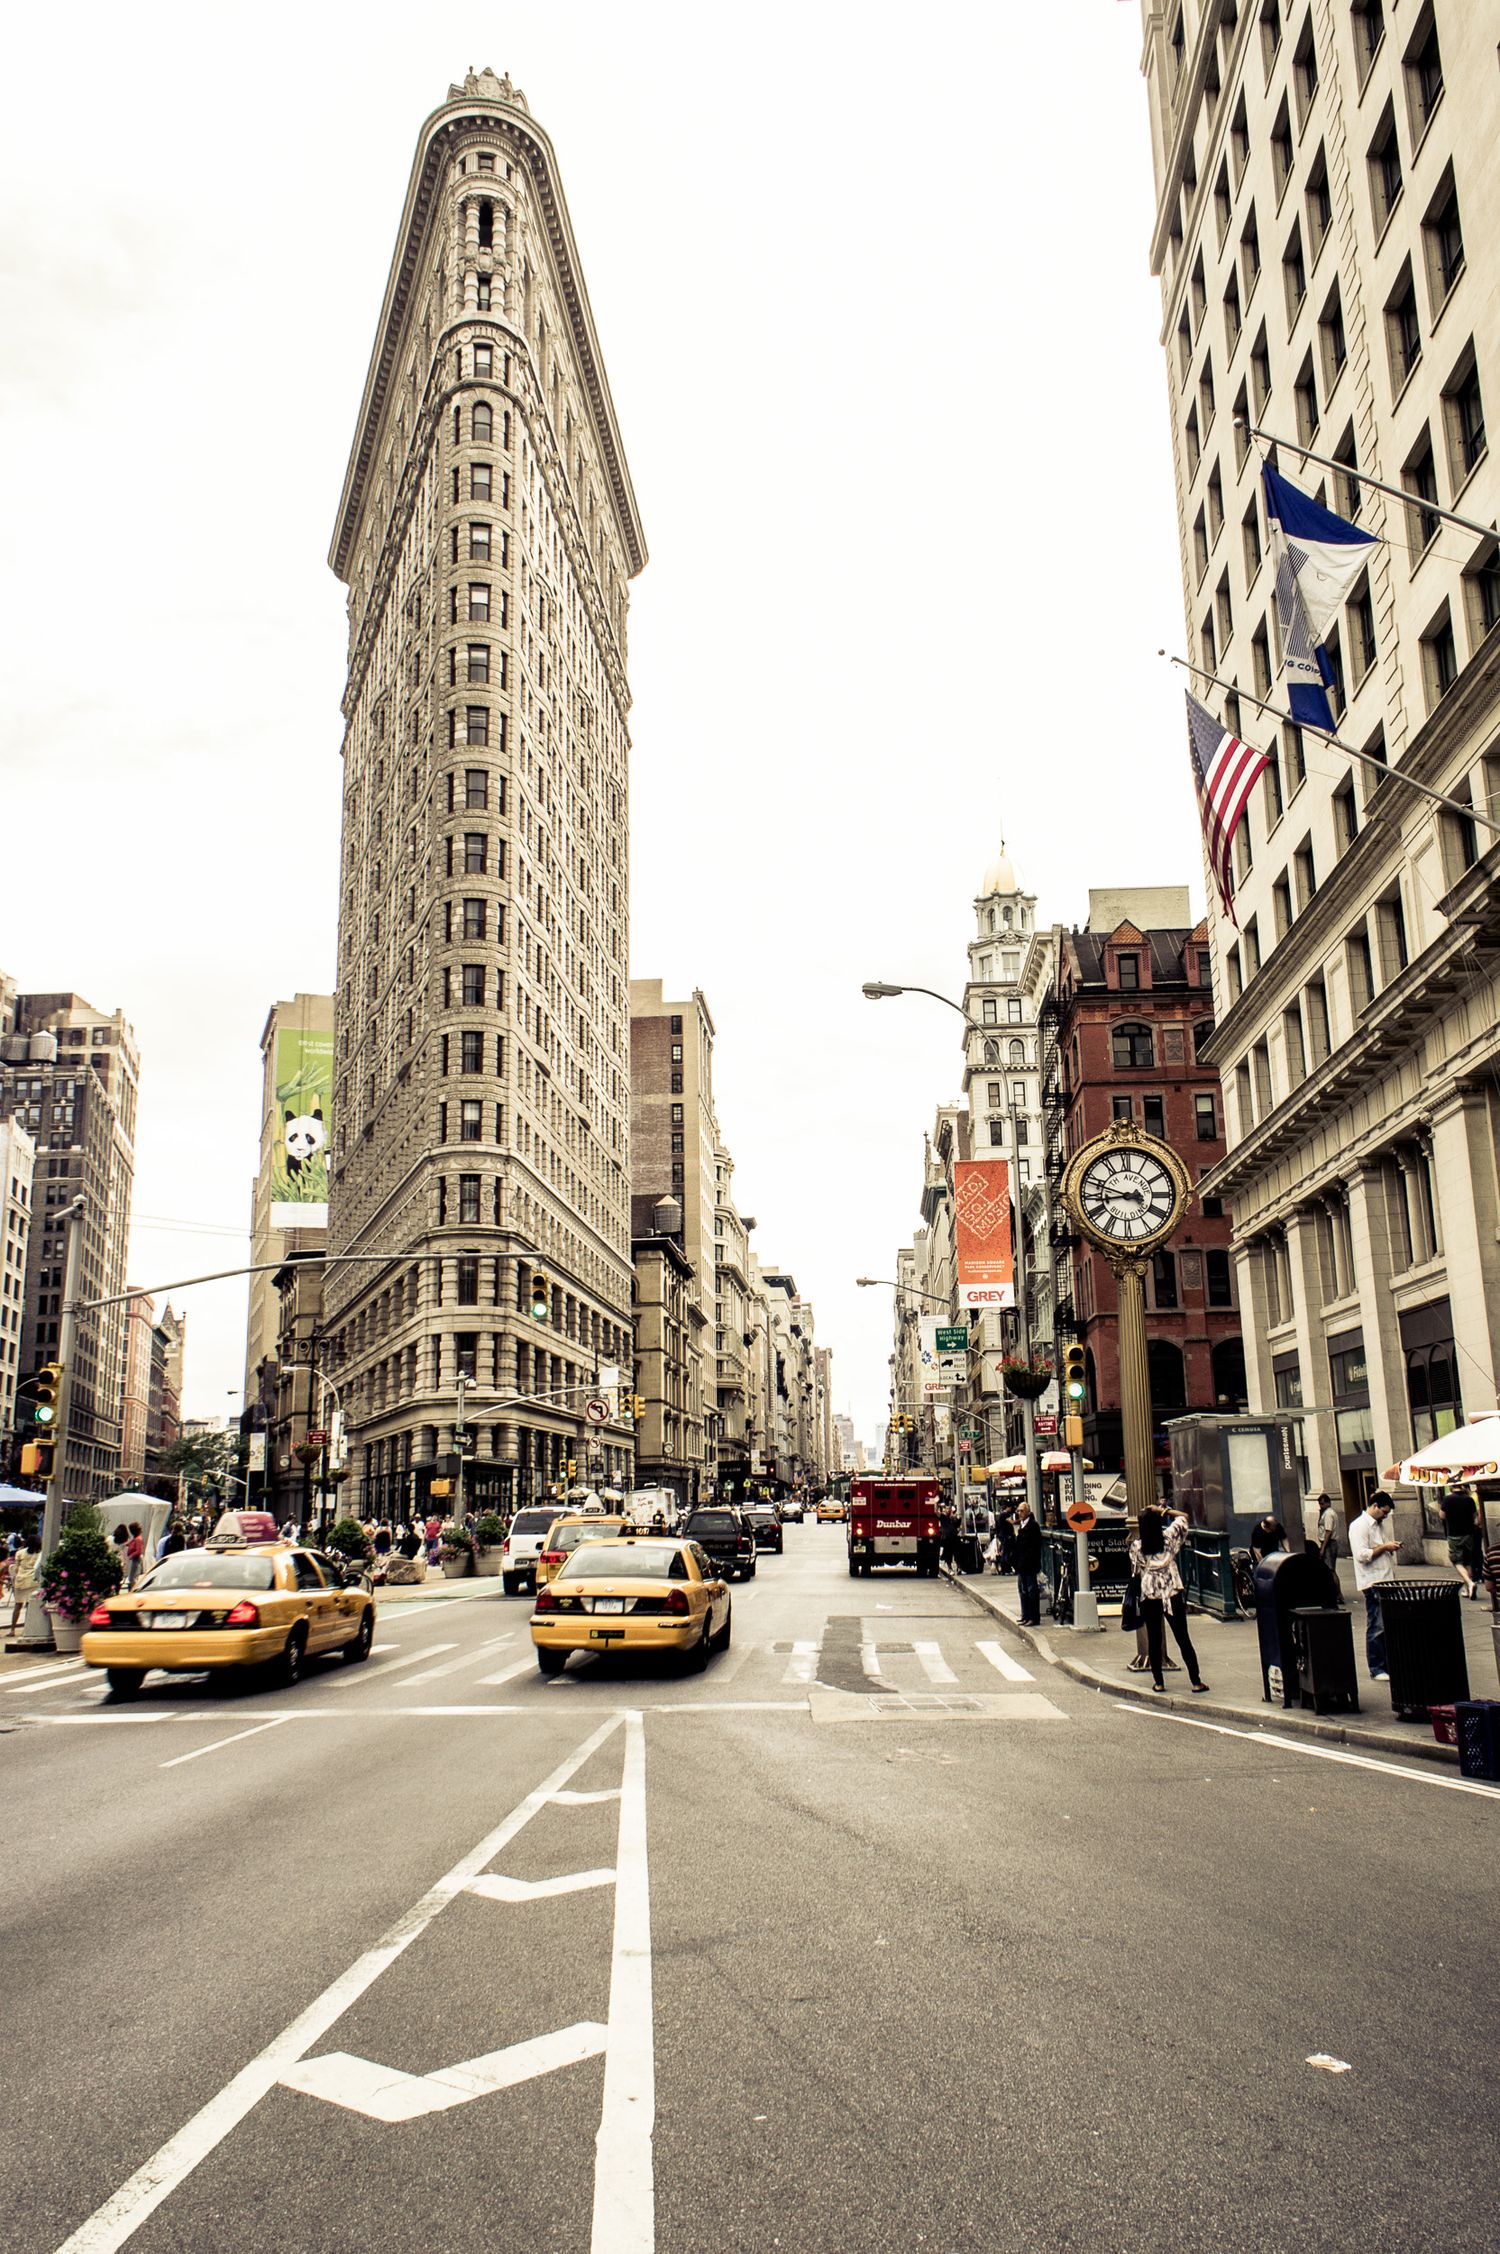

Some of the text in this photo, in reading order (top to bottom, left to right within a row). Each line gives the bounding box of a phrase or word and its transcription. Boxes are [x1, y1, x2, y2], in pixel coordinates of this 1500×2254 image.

[1123, 1174, 1151, 1196] AVENUE
[1110, 1203, 1148, 1220] BUILDING
[967, 1290, 1005, 1302] GREY
[1281, 1426, 1292, 1470] Newsstand
[1409, 1464, 1449, 1484] NUTS
[876, 1519, 912, 1529] Dunbar
[1087, 1538, 1126, 1547] reet Stat
